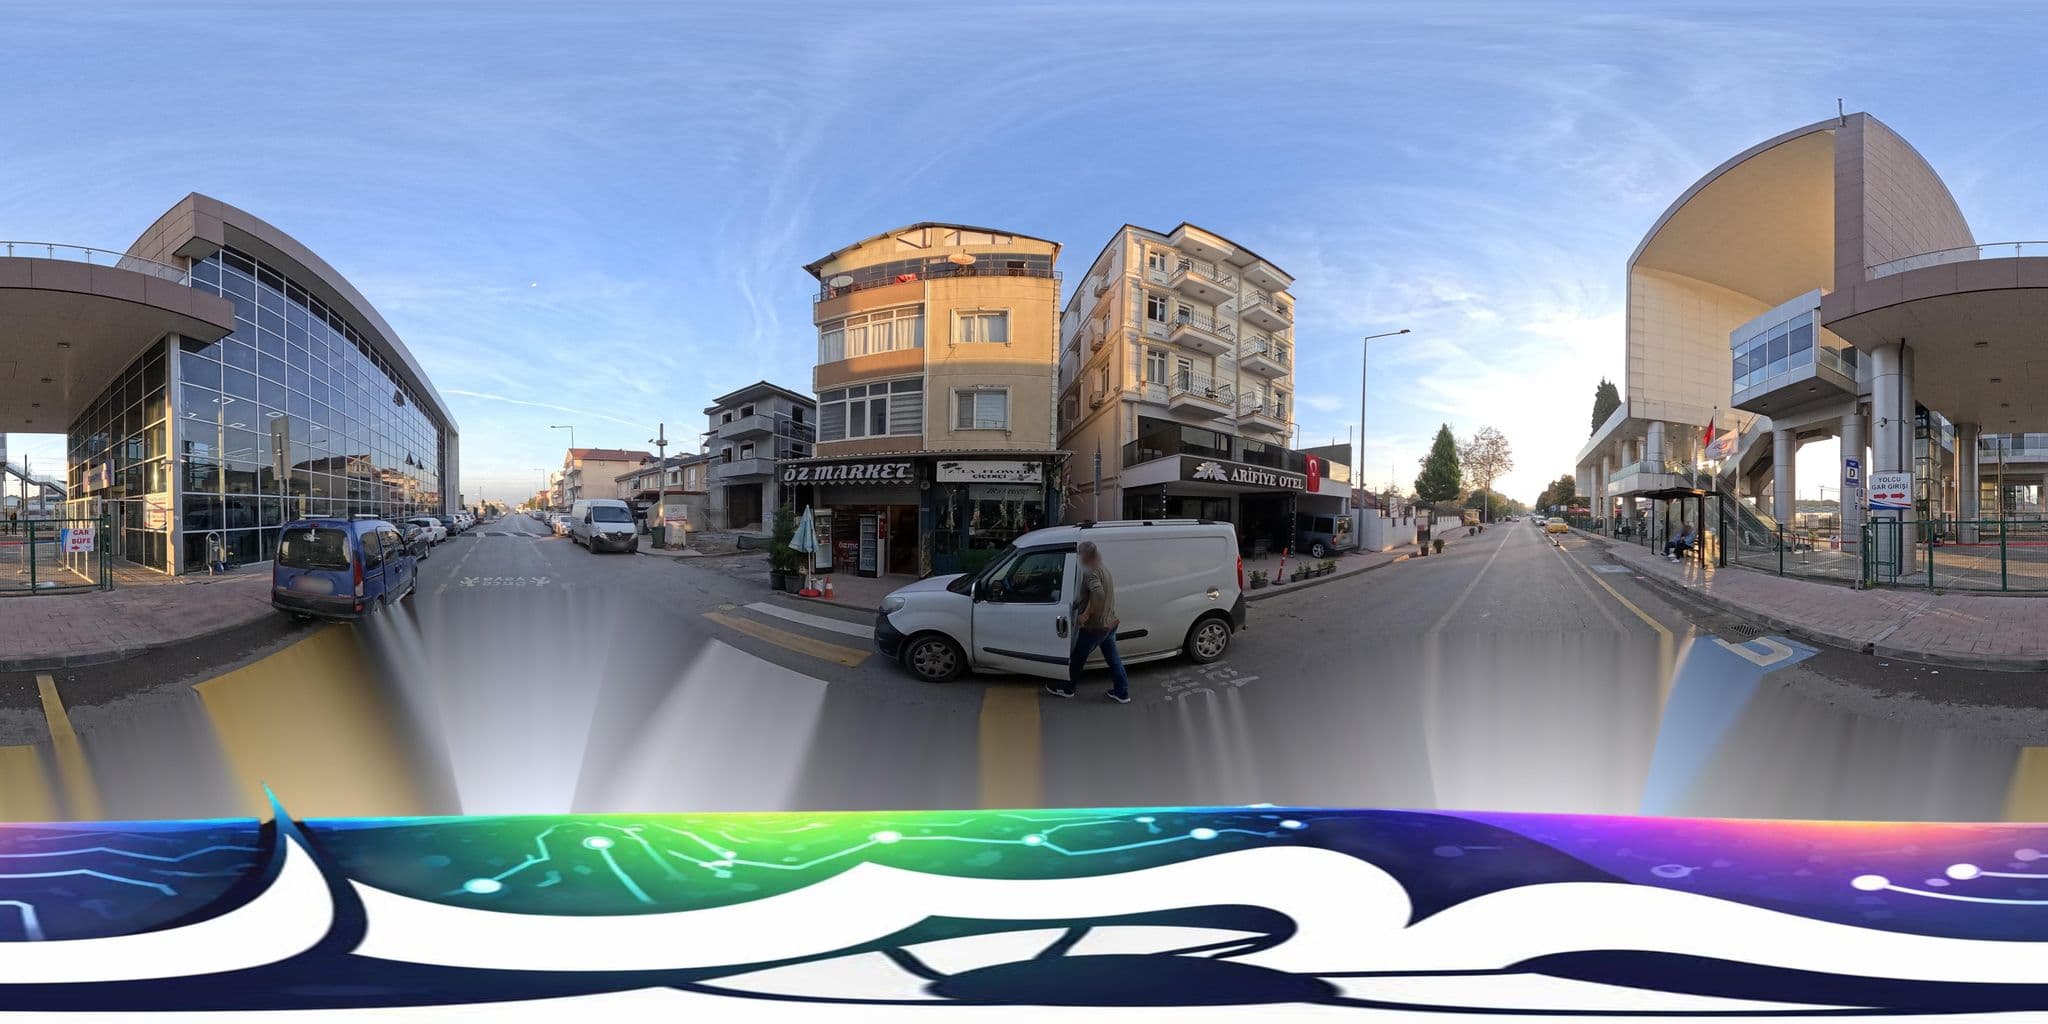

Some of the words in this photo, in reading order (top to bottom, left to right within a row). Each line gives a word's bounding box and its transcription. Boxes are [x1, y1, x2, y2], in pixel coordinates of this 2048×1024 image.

[784, 465, 809, 481] ÖZ
[814, 463, 911, 480] MARKET
[1231, 467, 1276, 486] ARİFİYE
[1279, 476, 1303, 489] OTEL
